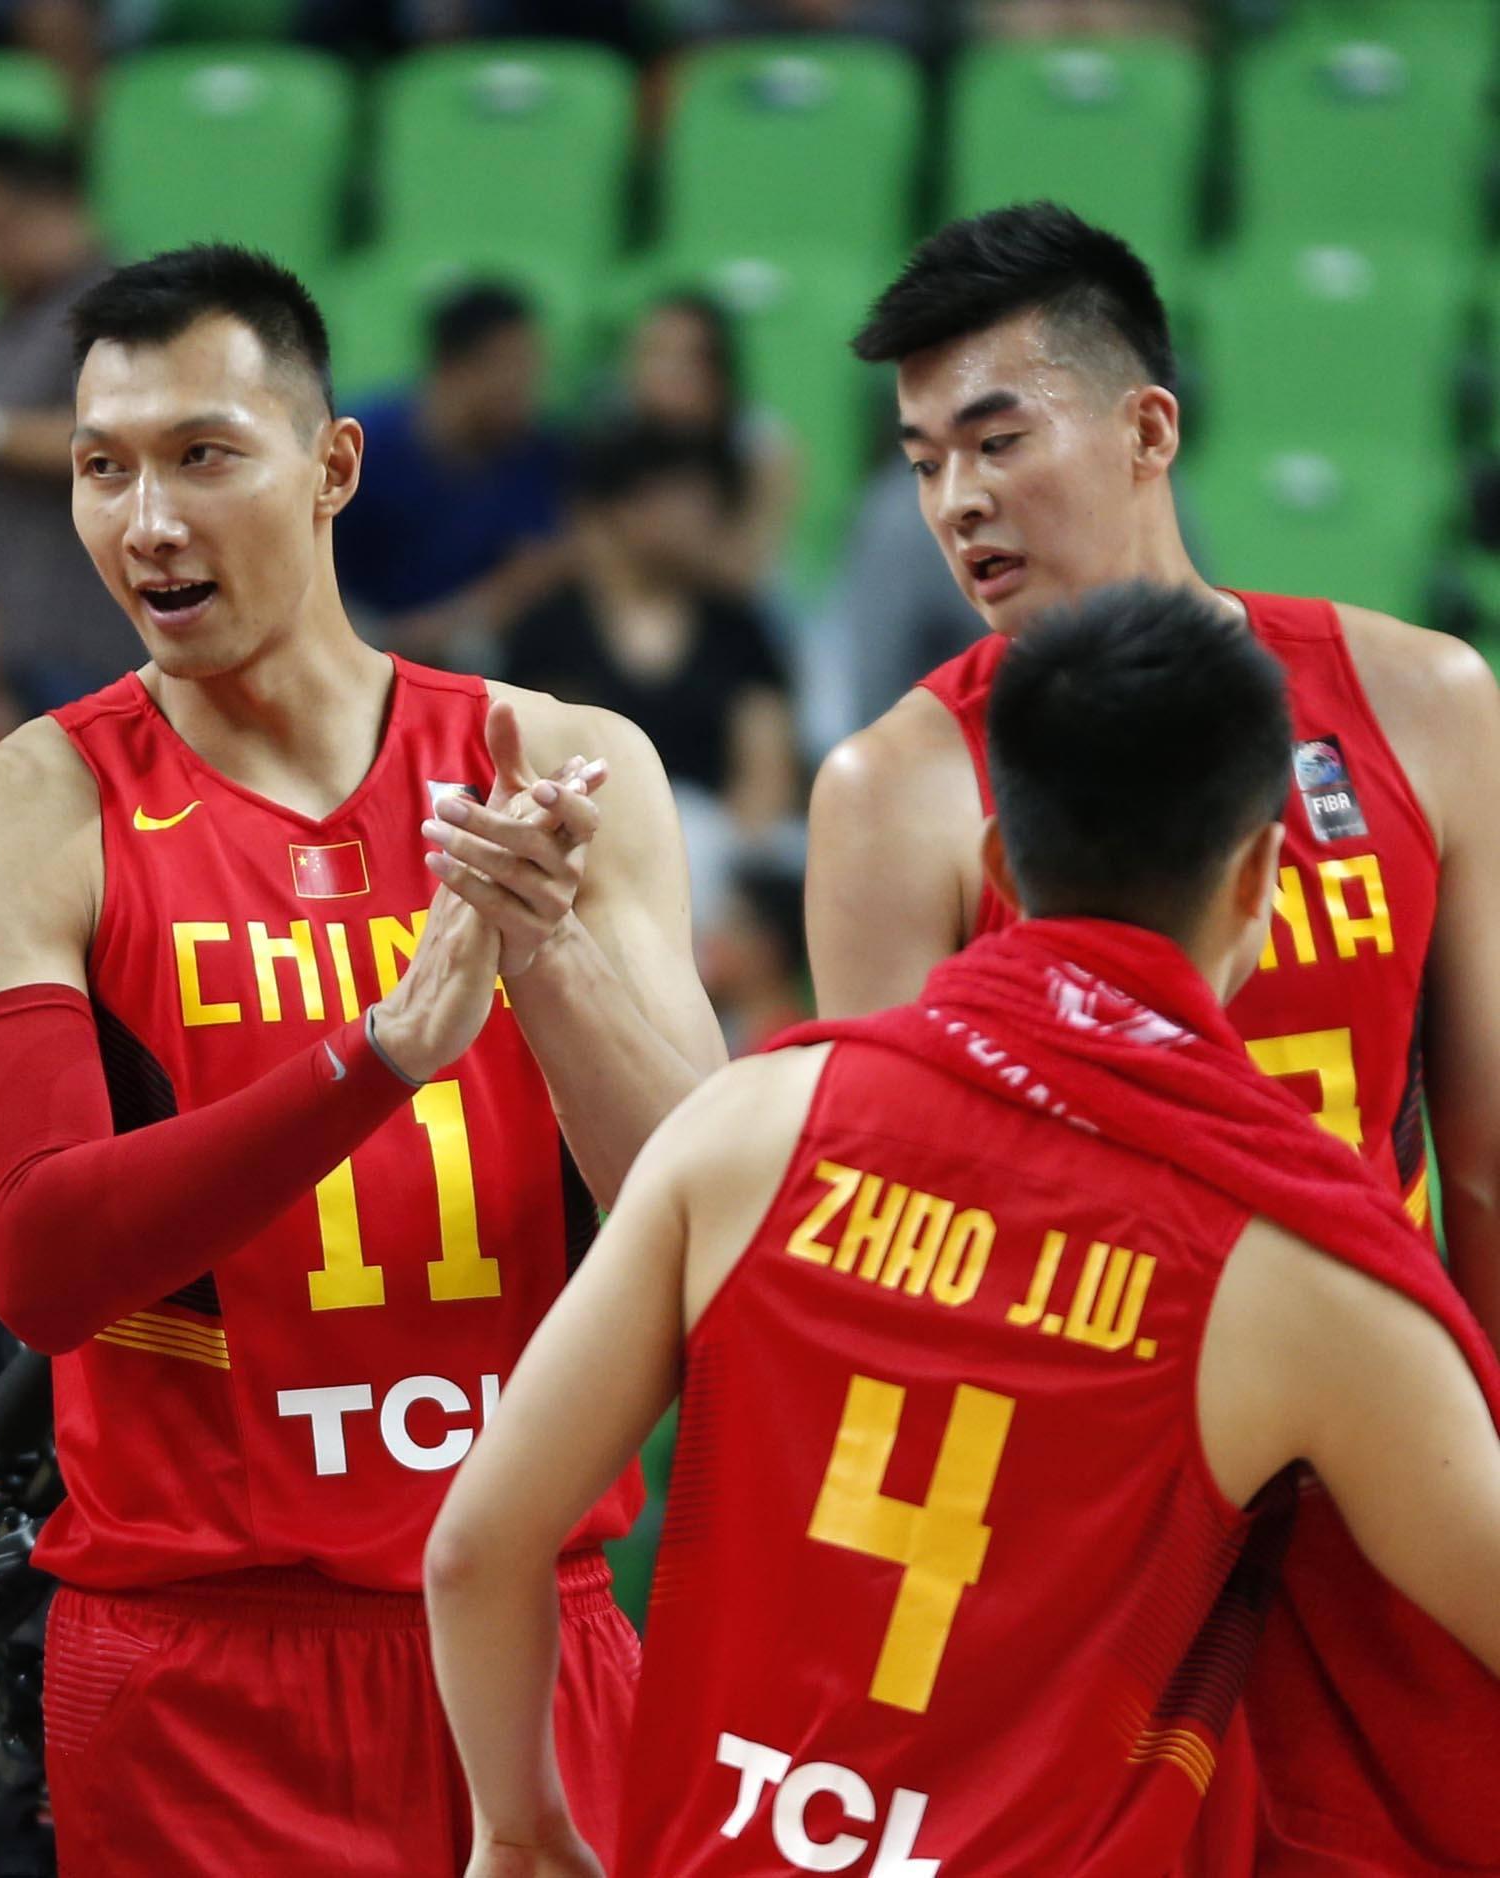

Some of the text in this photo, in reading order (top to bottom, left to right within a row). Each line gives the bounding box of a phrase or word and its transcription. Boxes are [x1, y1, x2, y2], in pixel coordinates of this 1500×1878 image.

[1311, 791, 1352, 815] FIBA
[172, 908, 513, 1027] CHIN
[307, 1078, 502, 1312] 11
[785, 1159, 1158, 1360] ZHAO J.W.
[806, 1373, 1017, 1714] 4
[715, 1731, 942, 1878] TCL
